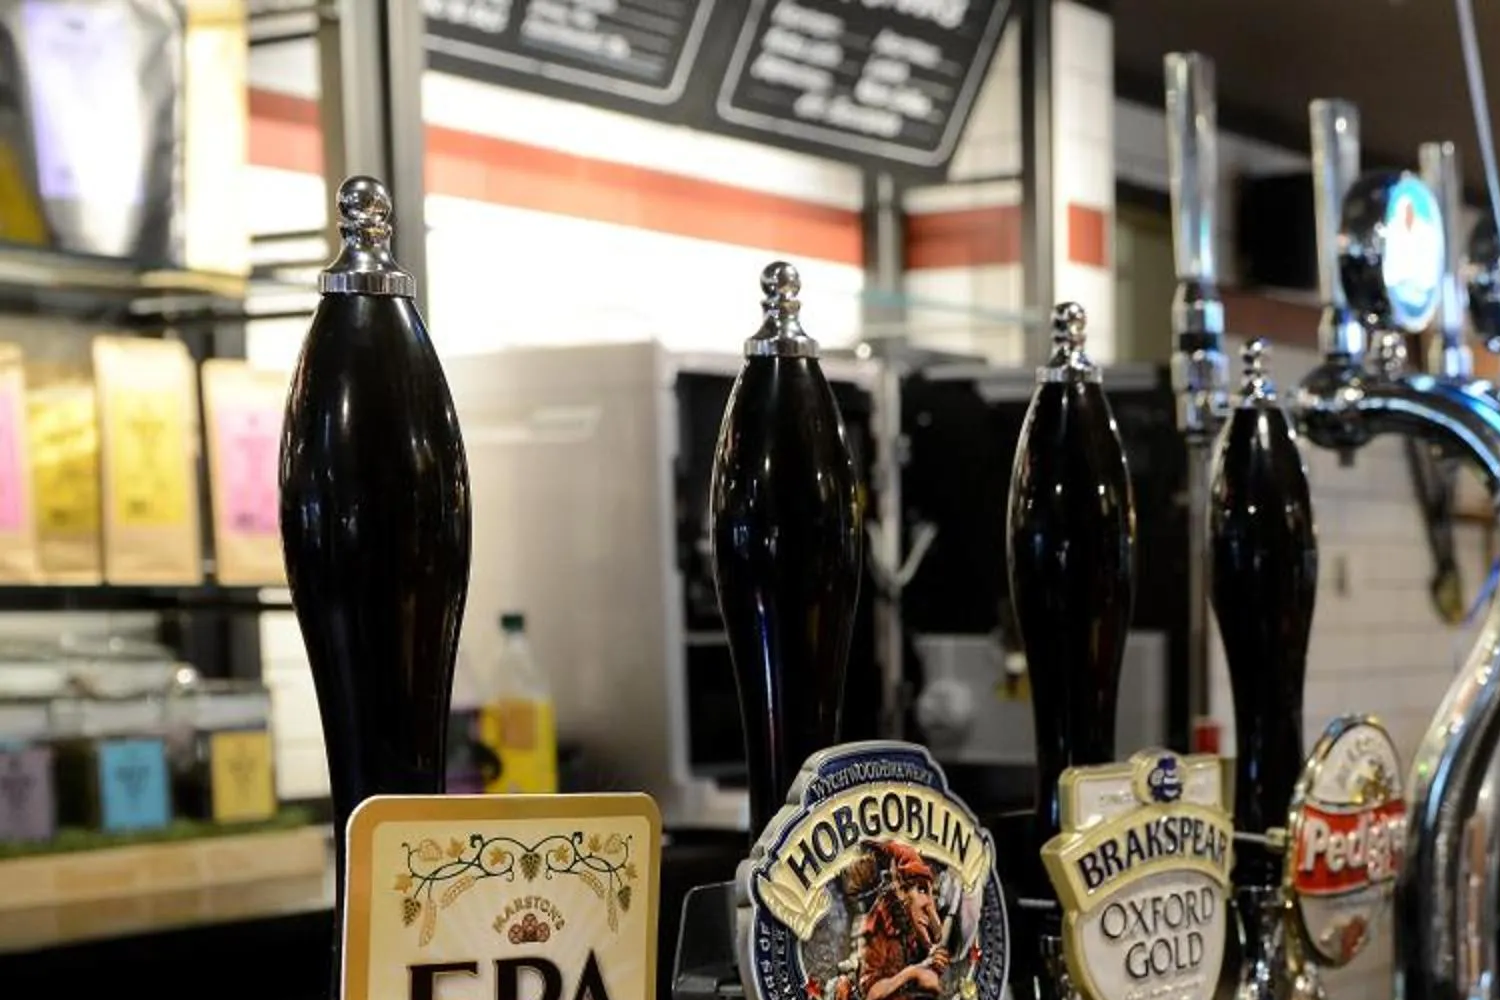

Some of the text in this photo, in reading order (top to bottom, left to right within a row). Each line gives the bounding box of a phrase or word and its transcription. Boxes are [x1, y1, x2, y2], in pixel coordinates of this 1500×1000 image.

[787, 792, 971, 889] HOBGOBLIN
[1078, 816, 1227, 890] BRAKSPEAR
[492, 895, 566, 934] MARSTON'S
[1101, 886, 1215, 940] OXFORD
[1125, 931, 1204, 980] GOLD
